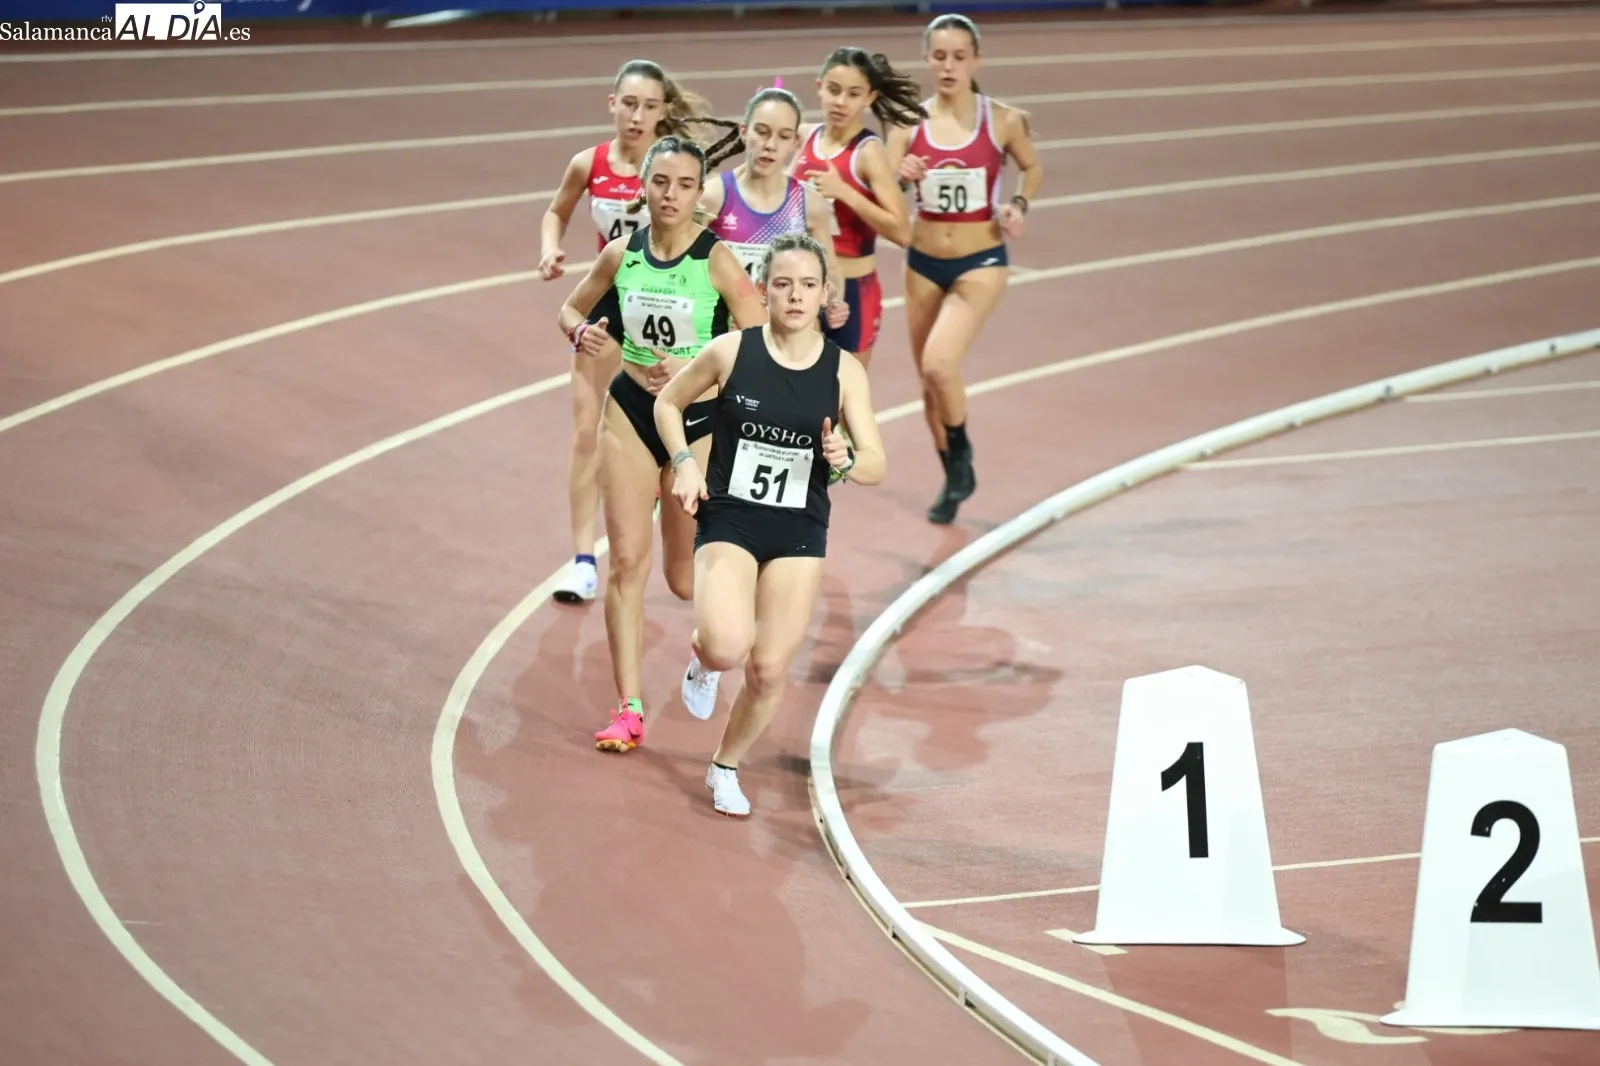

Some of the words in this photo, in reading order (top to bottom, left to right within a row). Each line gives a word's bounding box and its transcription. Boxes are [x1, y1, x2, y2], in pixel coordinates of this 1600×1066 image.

[938, 185, 967, 212] 50
[642, 314, 676, 347] 49
[741, 422, 812, 446] OYSHO
[750, 464, 789, 503] 51
[1161, 741, 1209, 859] 1
[1470, 800, 1543, 923] 2
